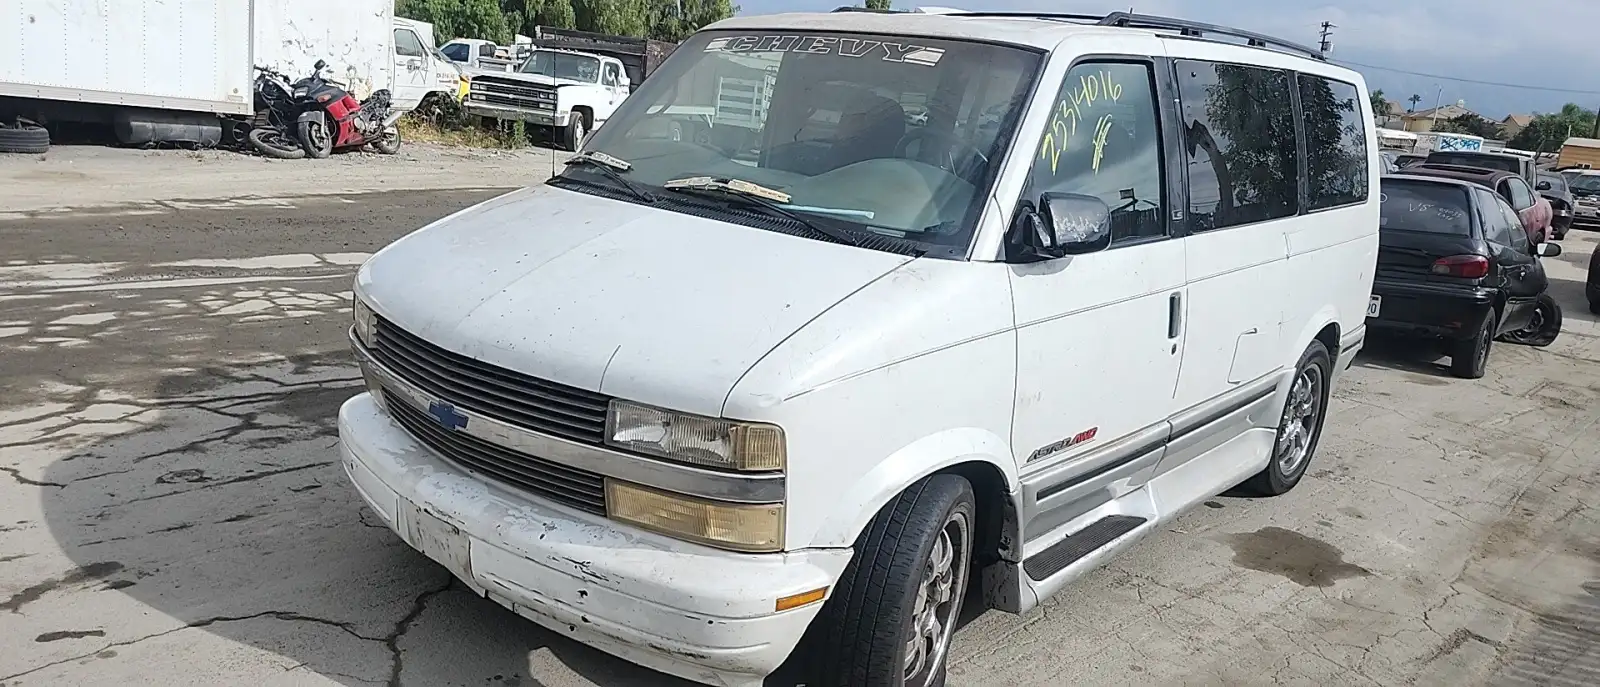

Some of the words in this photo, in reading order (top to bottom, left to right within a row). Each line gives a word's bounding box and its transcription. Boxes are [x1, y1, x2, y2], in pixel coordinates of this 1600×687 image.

[722, 36, 927, 63] CHEVY
[1026, 437, 1072, 463] ASTRO
[1070, 427, 1098, 446] AWD
